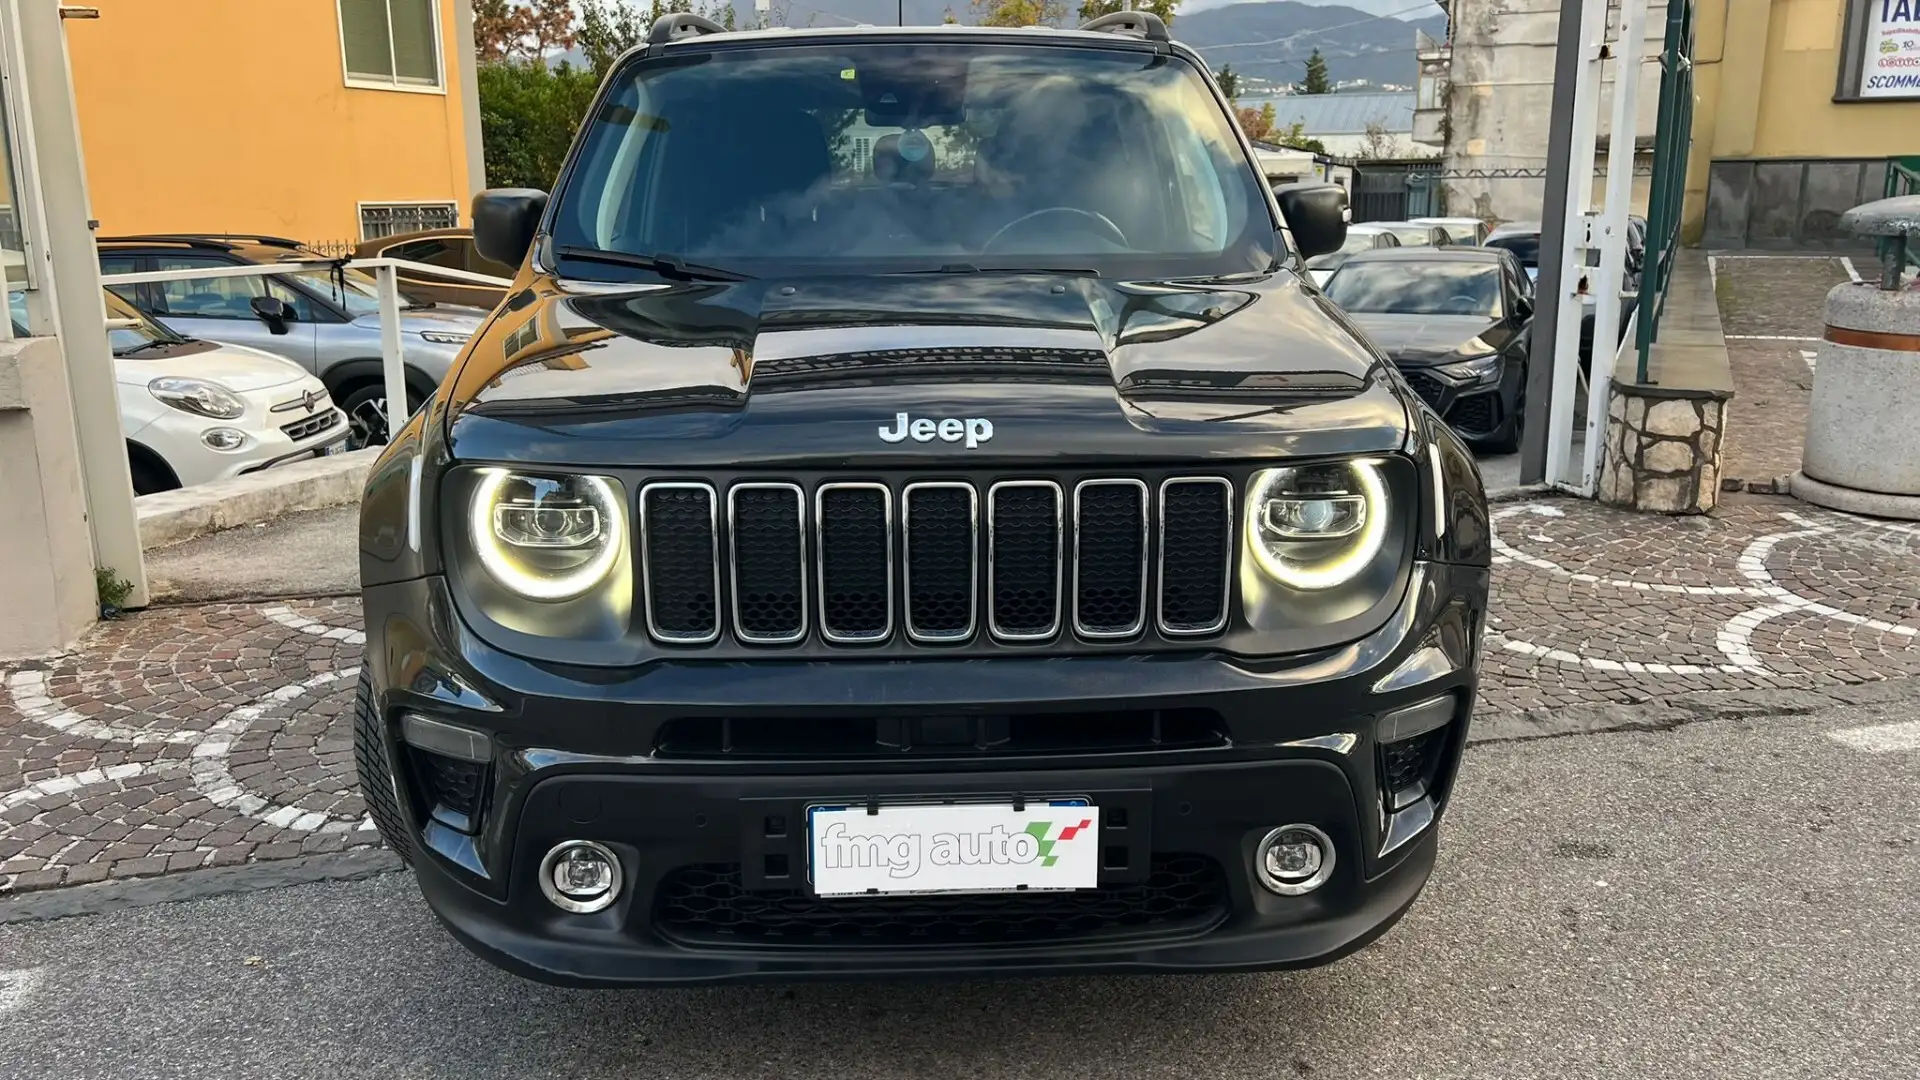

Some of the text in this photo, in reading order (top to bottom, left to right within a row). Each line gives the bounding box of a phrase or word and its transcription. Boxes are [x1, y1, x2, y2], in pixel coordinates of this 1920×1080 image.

[878, 412, 993, 449] Jeep
[821, 822, 1040, 878] fmg auto
